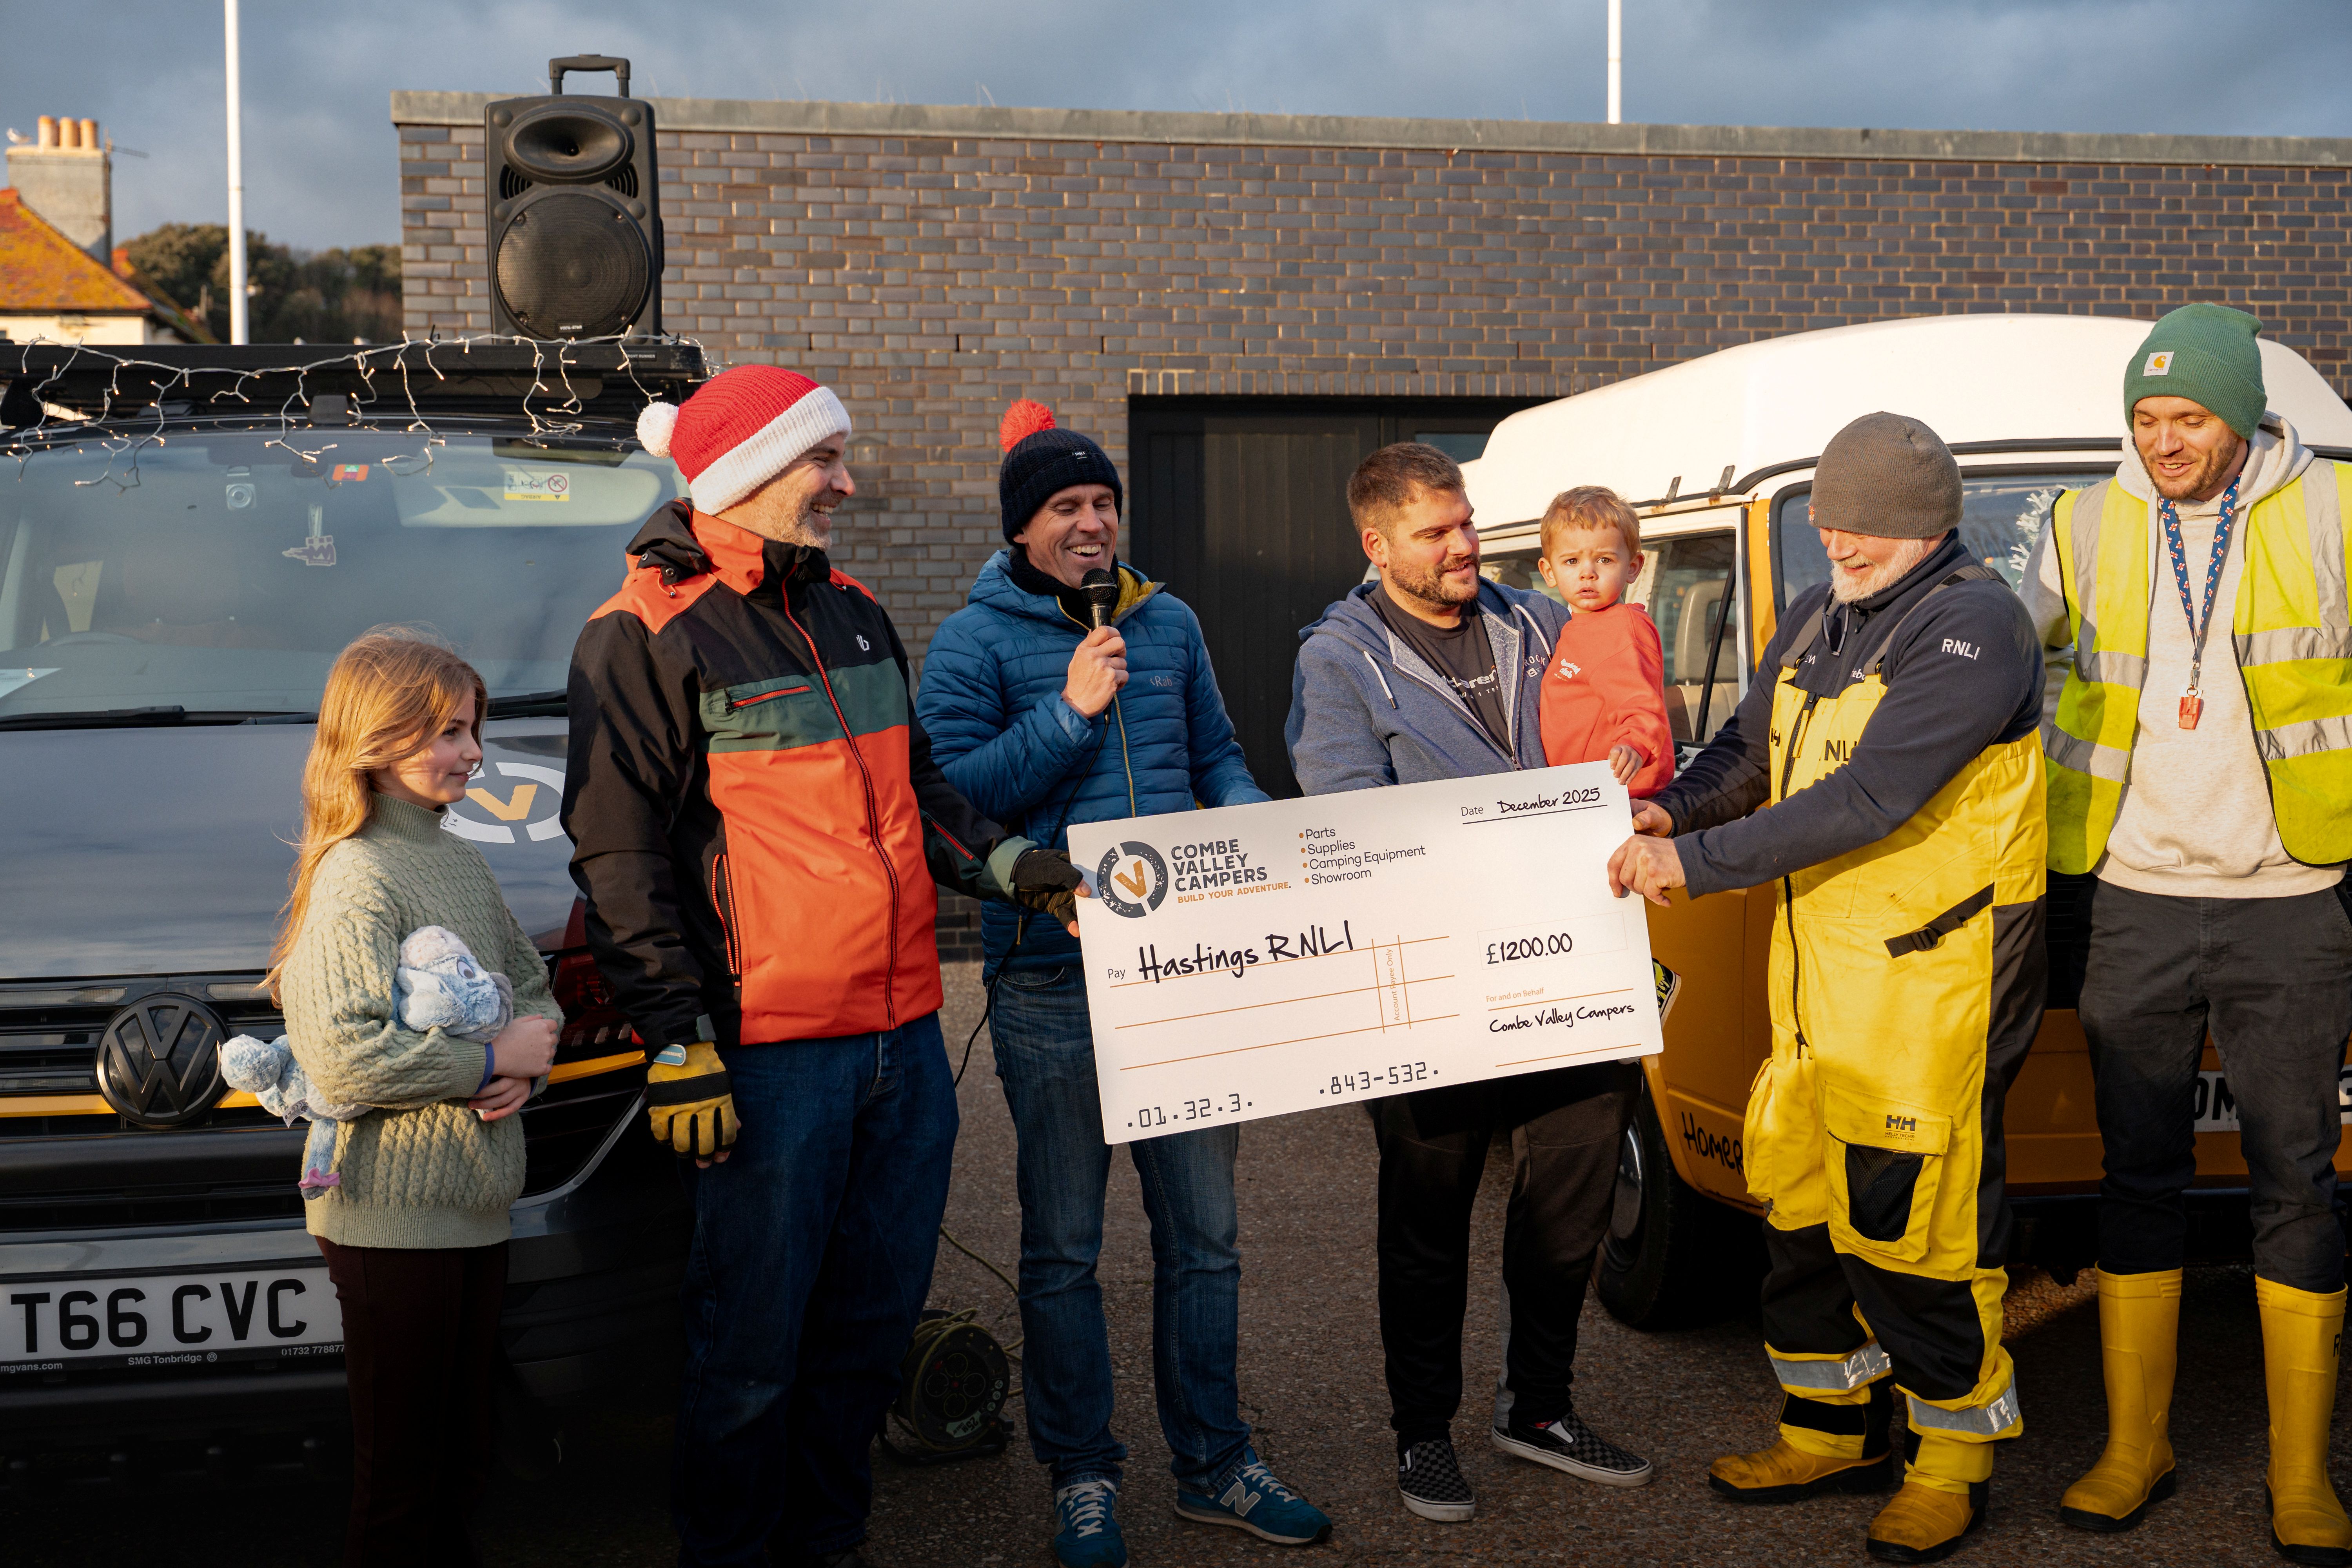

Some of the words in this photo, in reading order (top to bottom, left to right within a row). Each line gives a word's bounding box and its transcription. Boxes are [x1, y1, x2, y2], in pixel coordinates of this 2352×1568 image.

[1942, 639, 1980, 660] RNLI
[1155, 676, 1172, 686] Rab
[1461, 806, 1484, 816] Date
[1497, 794, 1558, 813] December
[1563, 787, 1600, 804] 2025
[1306, 828, 1336, 840] Parts
[1171, 839, 1239, 860] COMBE
[1308, 840, 1355, 856] Supplies
[1310, 855, 1361, 869] Camping
[1364, 846, 1426, 864] Equipment
[1172, 853, 1249, 876] VALLEY
[1175, 867, 1268, 892] CAMPERS
[1312, 870, 1372, 885] Showroom
[1178, 894, 1205, 904] BUILD
[1208, 889, 1233, 899] YOUR
[1237, 882, 1291, 896] ADVENTURE.
[1108, 969, 1125, 980] Pay
[1138, 943, 1259, 984] Hastings
[1265, 920, 1353, 961] RNLI
[1486, 933, 1572, 964] £1200.00
[1523, 987, 1544, 997] Behalf
[1392, 990, 1400, 1021] Account
[1490, 1015, 1532, 1033] Combe
[1535, 1008, 1574, 1028] Valley
[1576, 1005, 1635, 1021] Campers
[11, 1288, 147, 1353] T66
[172, 1279, 307, 1344] CVC
[0, 1363, 63, 1373] mgvans.com
[128, 1356, 151, 1365] SMG
[153, 1354, 202, 1363] Tonbridge
[281, 1347, 309, 1356] 01732
[312, 1345, 345, 1354] 778877
